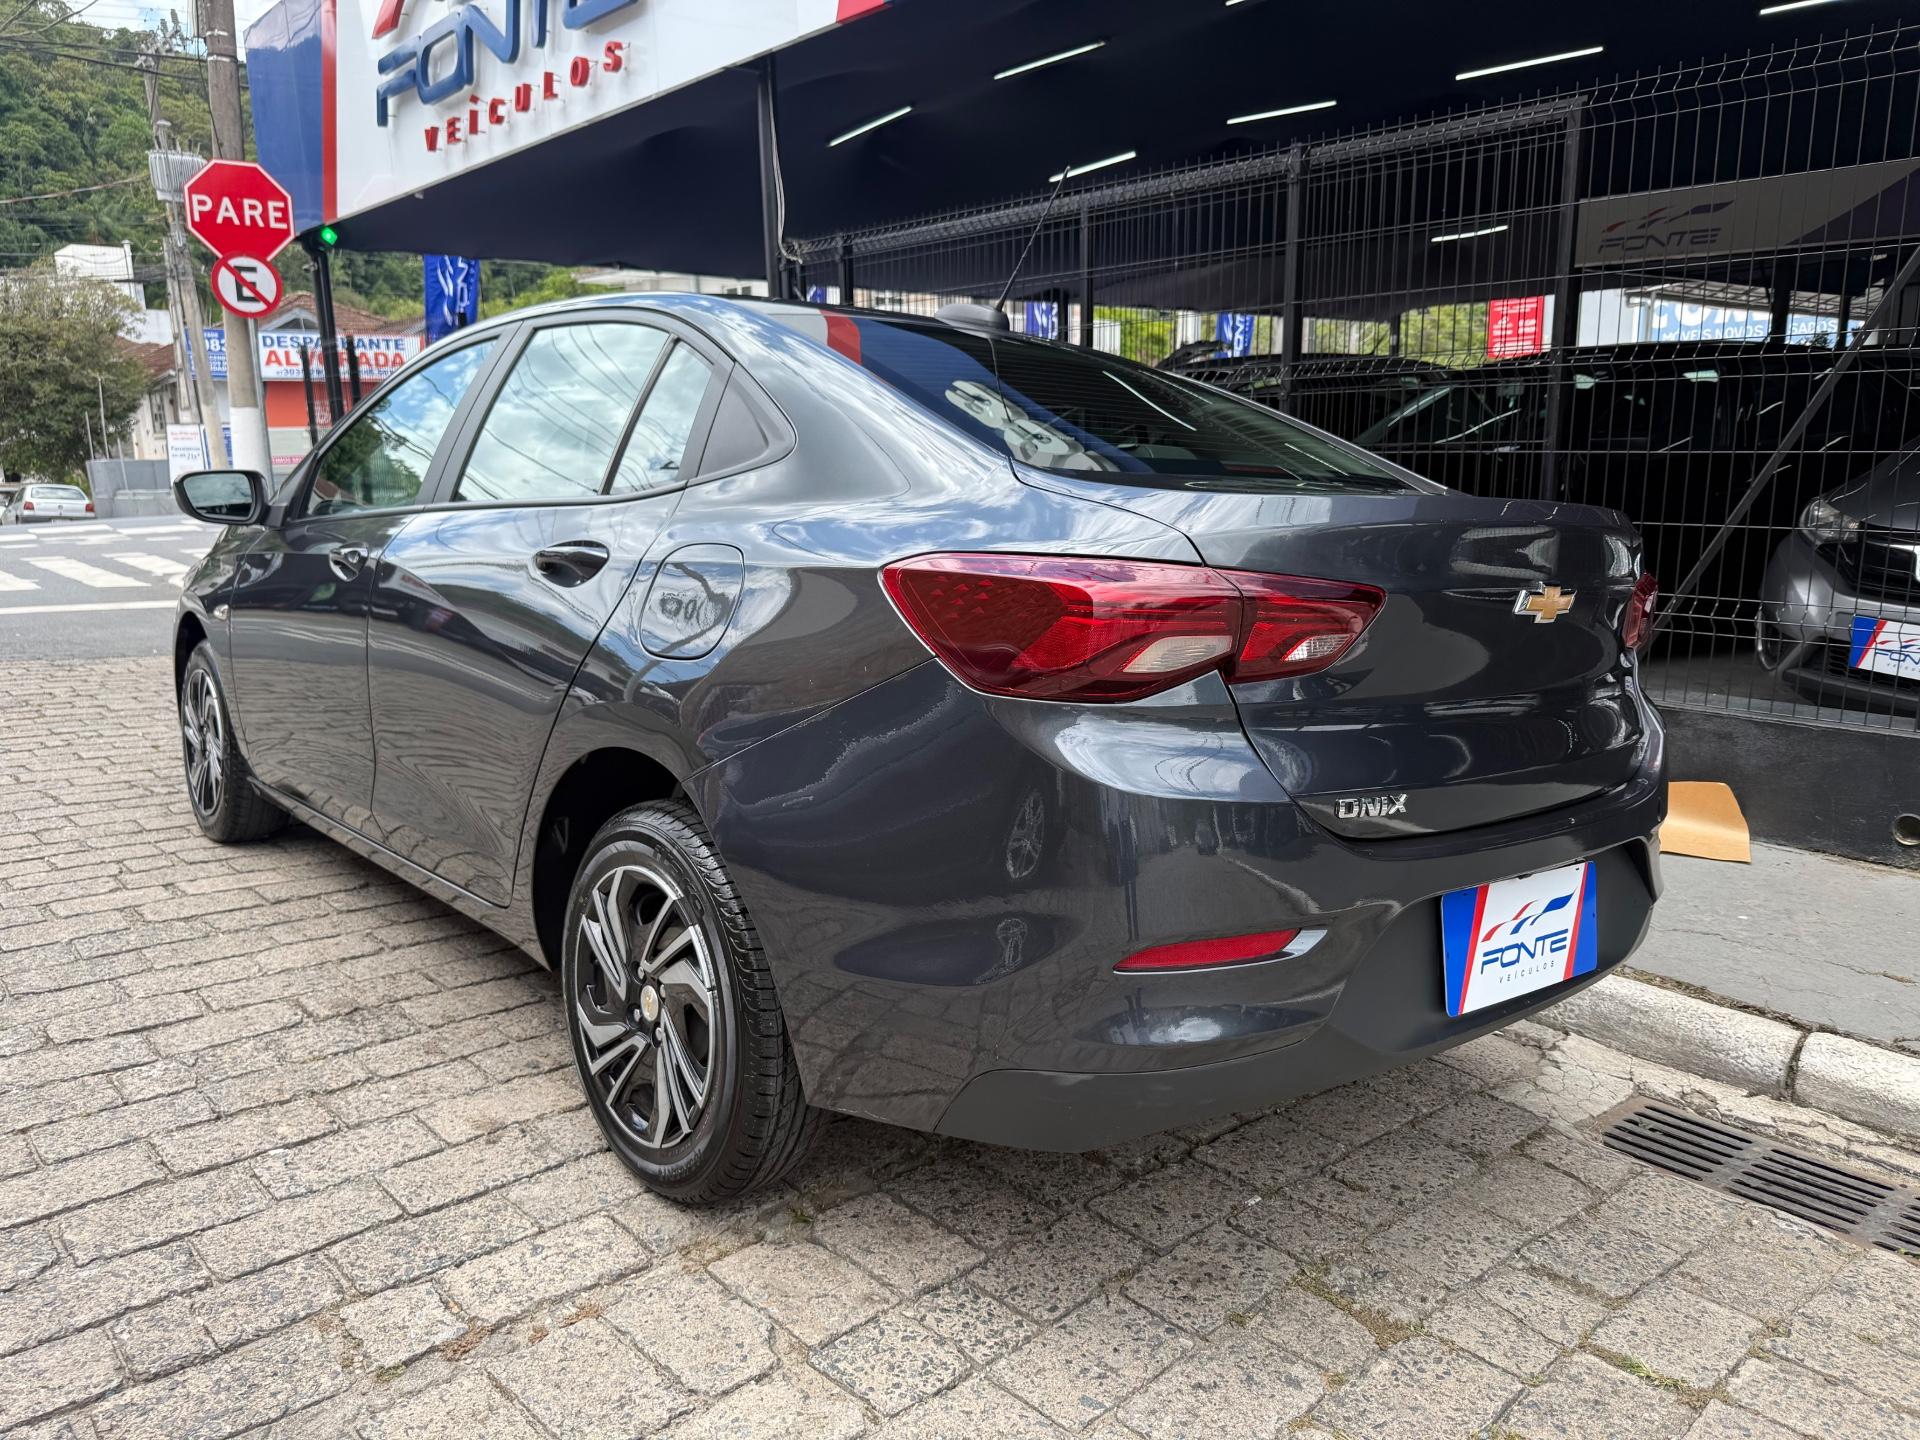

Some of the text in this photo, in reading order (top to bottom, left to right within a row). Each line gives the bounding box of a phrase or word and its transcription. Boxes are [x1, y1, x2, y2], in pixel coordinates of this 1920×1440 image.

[424, 41, 623, 152] VEÍCULOS
[191, 194, 288, 229] PARE
[1598, 227, 1721, 254] FONTE
[233, 265, 261, 302] E
[1715, 324, 1764, 340] NOVOS
[1790, 319, 1838, 335] SADOS
[1335, 793, 1408, 819] ONIX
[1480, 928, 1569, 976] FONTE
[1499, 960, 1555, 984] VEÍCULOS
